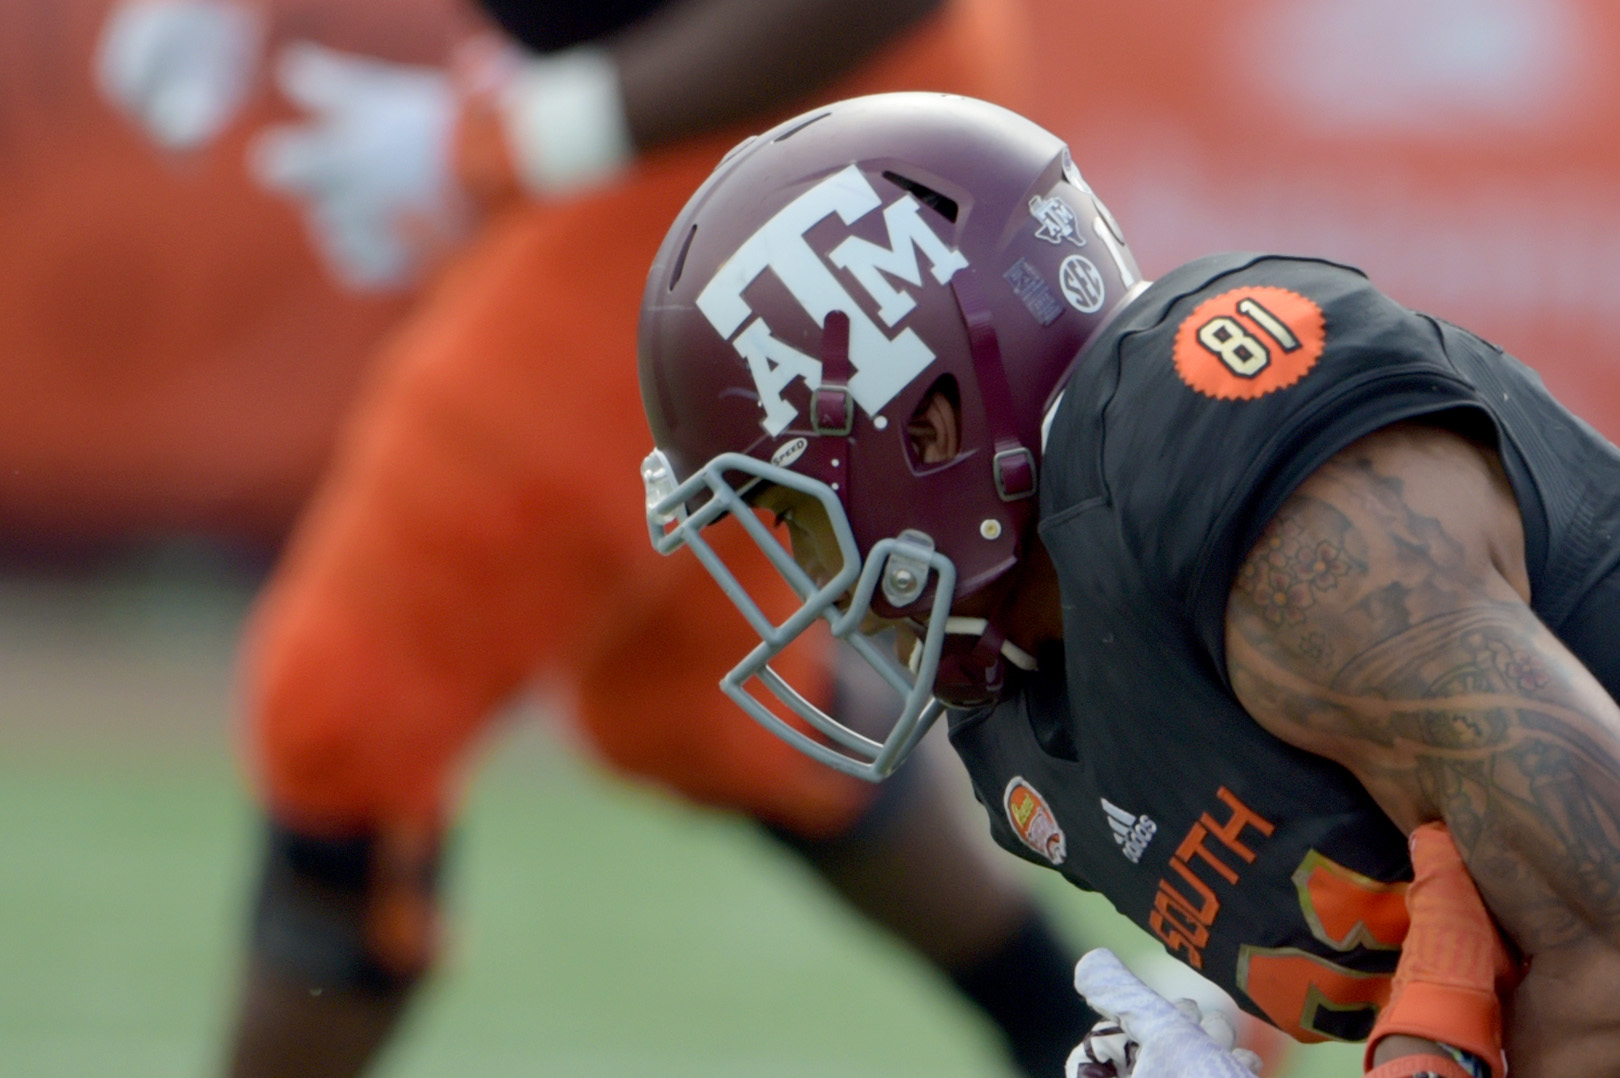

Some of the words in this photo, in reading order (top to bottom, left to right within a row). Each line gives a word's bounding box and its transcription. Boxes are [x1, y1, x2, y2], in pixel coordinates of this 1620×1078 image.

[1062, 257, 1101, 310] SEC
[1196, 297, 1303, 379] 81
[773, 440, 804, 466] SPEED
[1149, 785, 1276, 968] SOUTH
